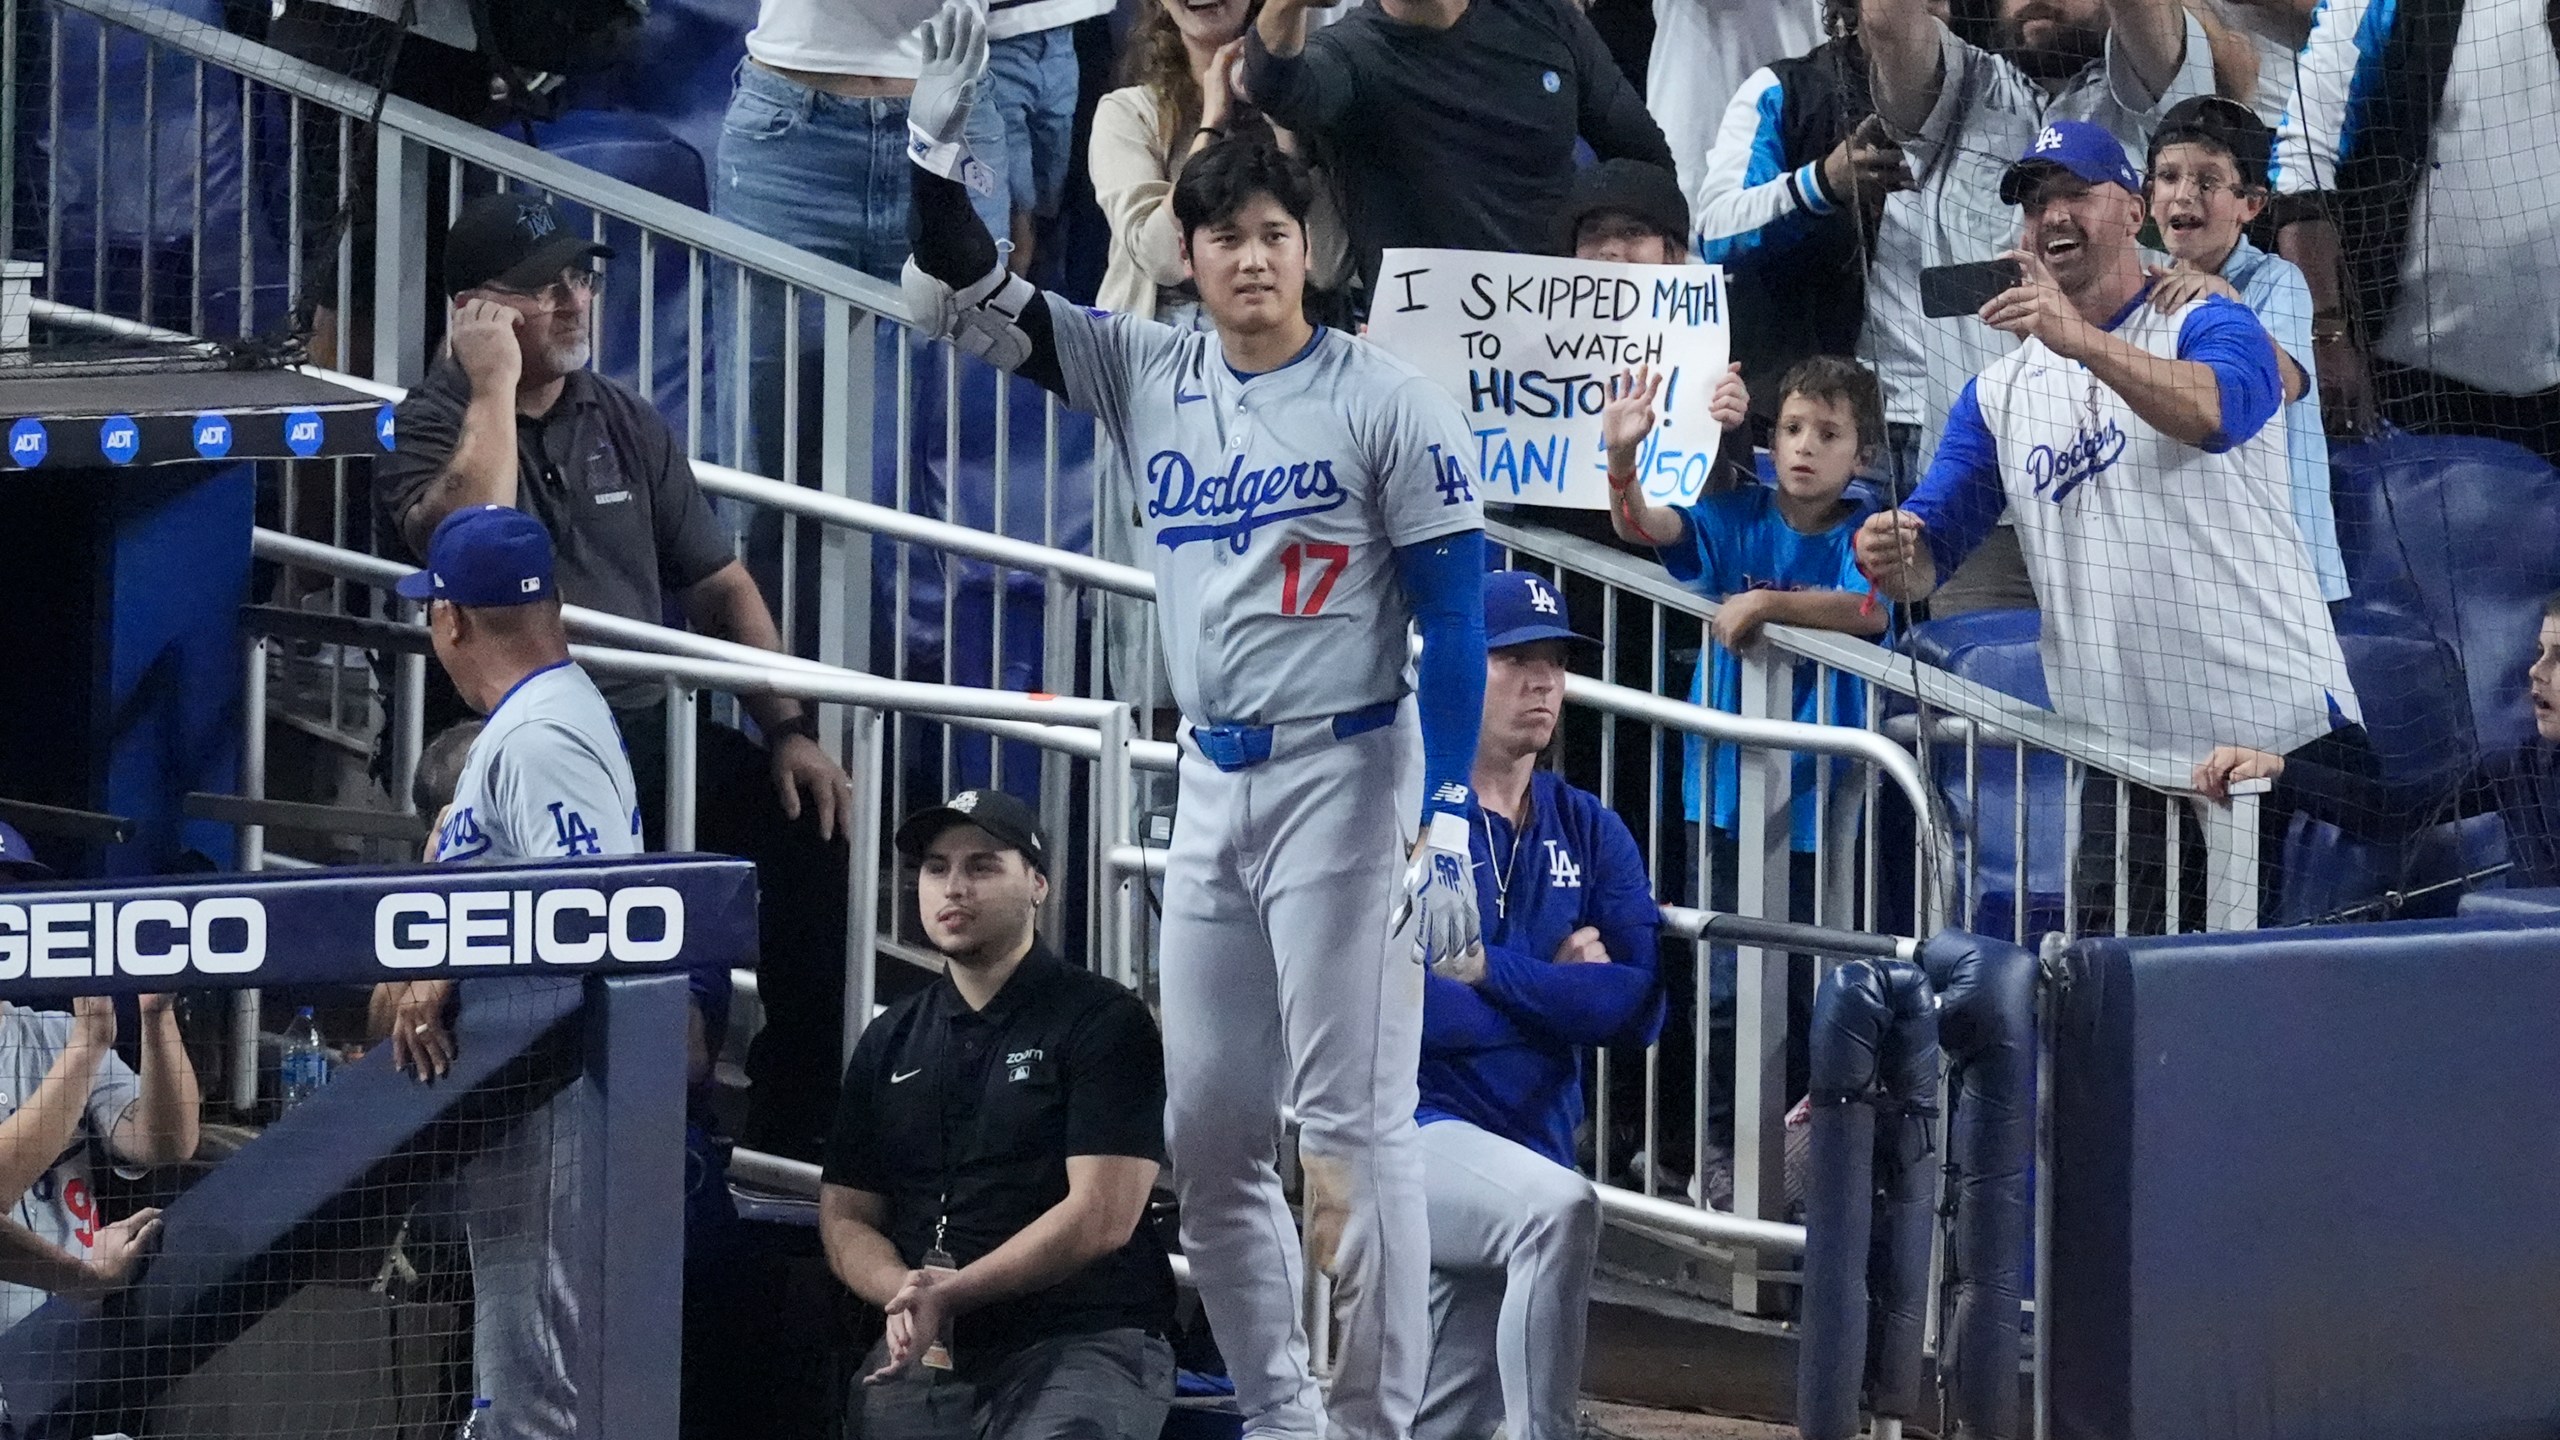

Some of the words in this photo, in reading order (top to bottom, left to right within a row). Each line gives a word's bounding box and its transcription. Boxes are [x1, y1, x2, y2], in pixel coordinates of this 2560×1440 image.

[2035, 125, 2063, 153] LA
[1394, 268, 1431, 313] I
[1460, 272, 1640, 322] SKIPPED
[1652, 273, 1721, 327] MATH
[1460, 330, 1501, 360] TO
[1545, 331, 1664, 366] WATCH
[14, 433, 42, 452] ADT
[106, 429, 134, 449] ADT
[199, 426, 226, 446] ADT
[290, 422, 318, 442] ADT
[1427, 443, 1473, 506] LA
[1474, 427, 1569, 495] TANI
[1147, 450, 1347, 555] Dodgers
[1280, 543, 1349, 616] 17
[1525, 578, 1558, 615] LA
[547, 801, 601, 857] LA
[1543, 839, 1580, 887] LA
[375, 887, 684, 968] GEICO
[1006, 1049, 1043, 1064] zoom
